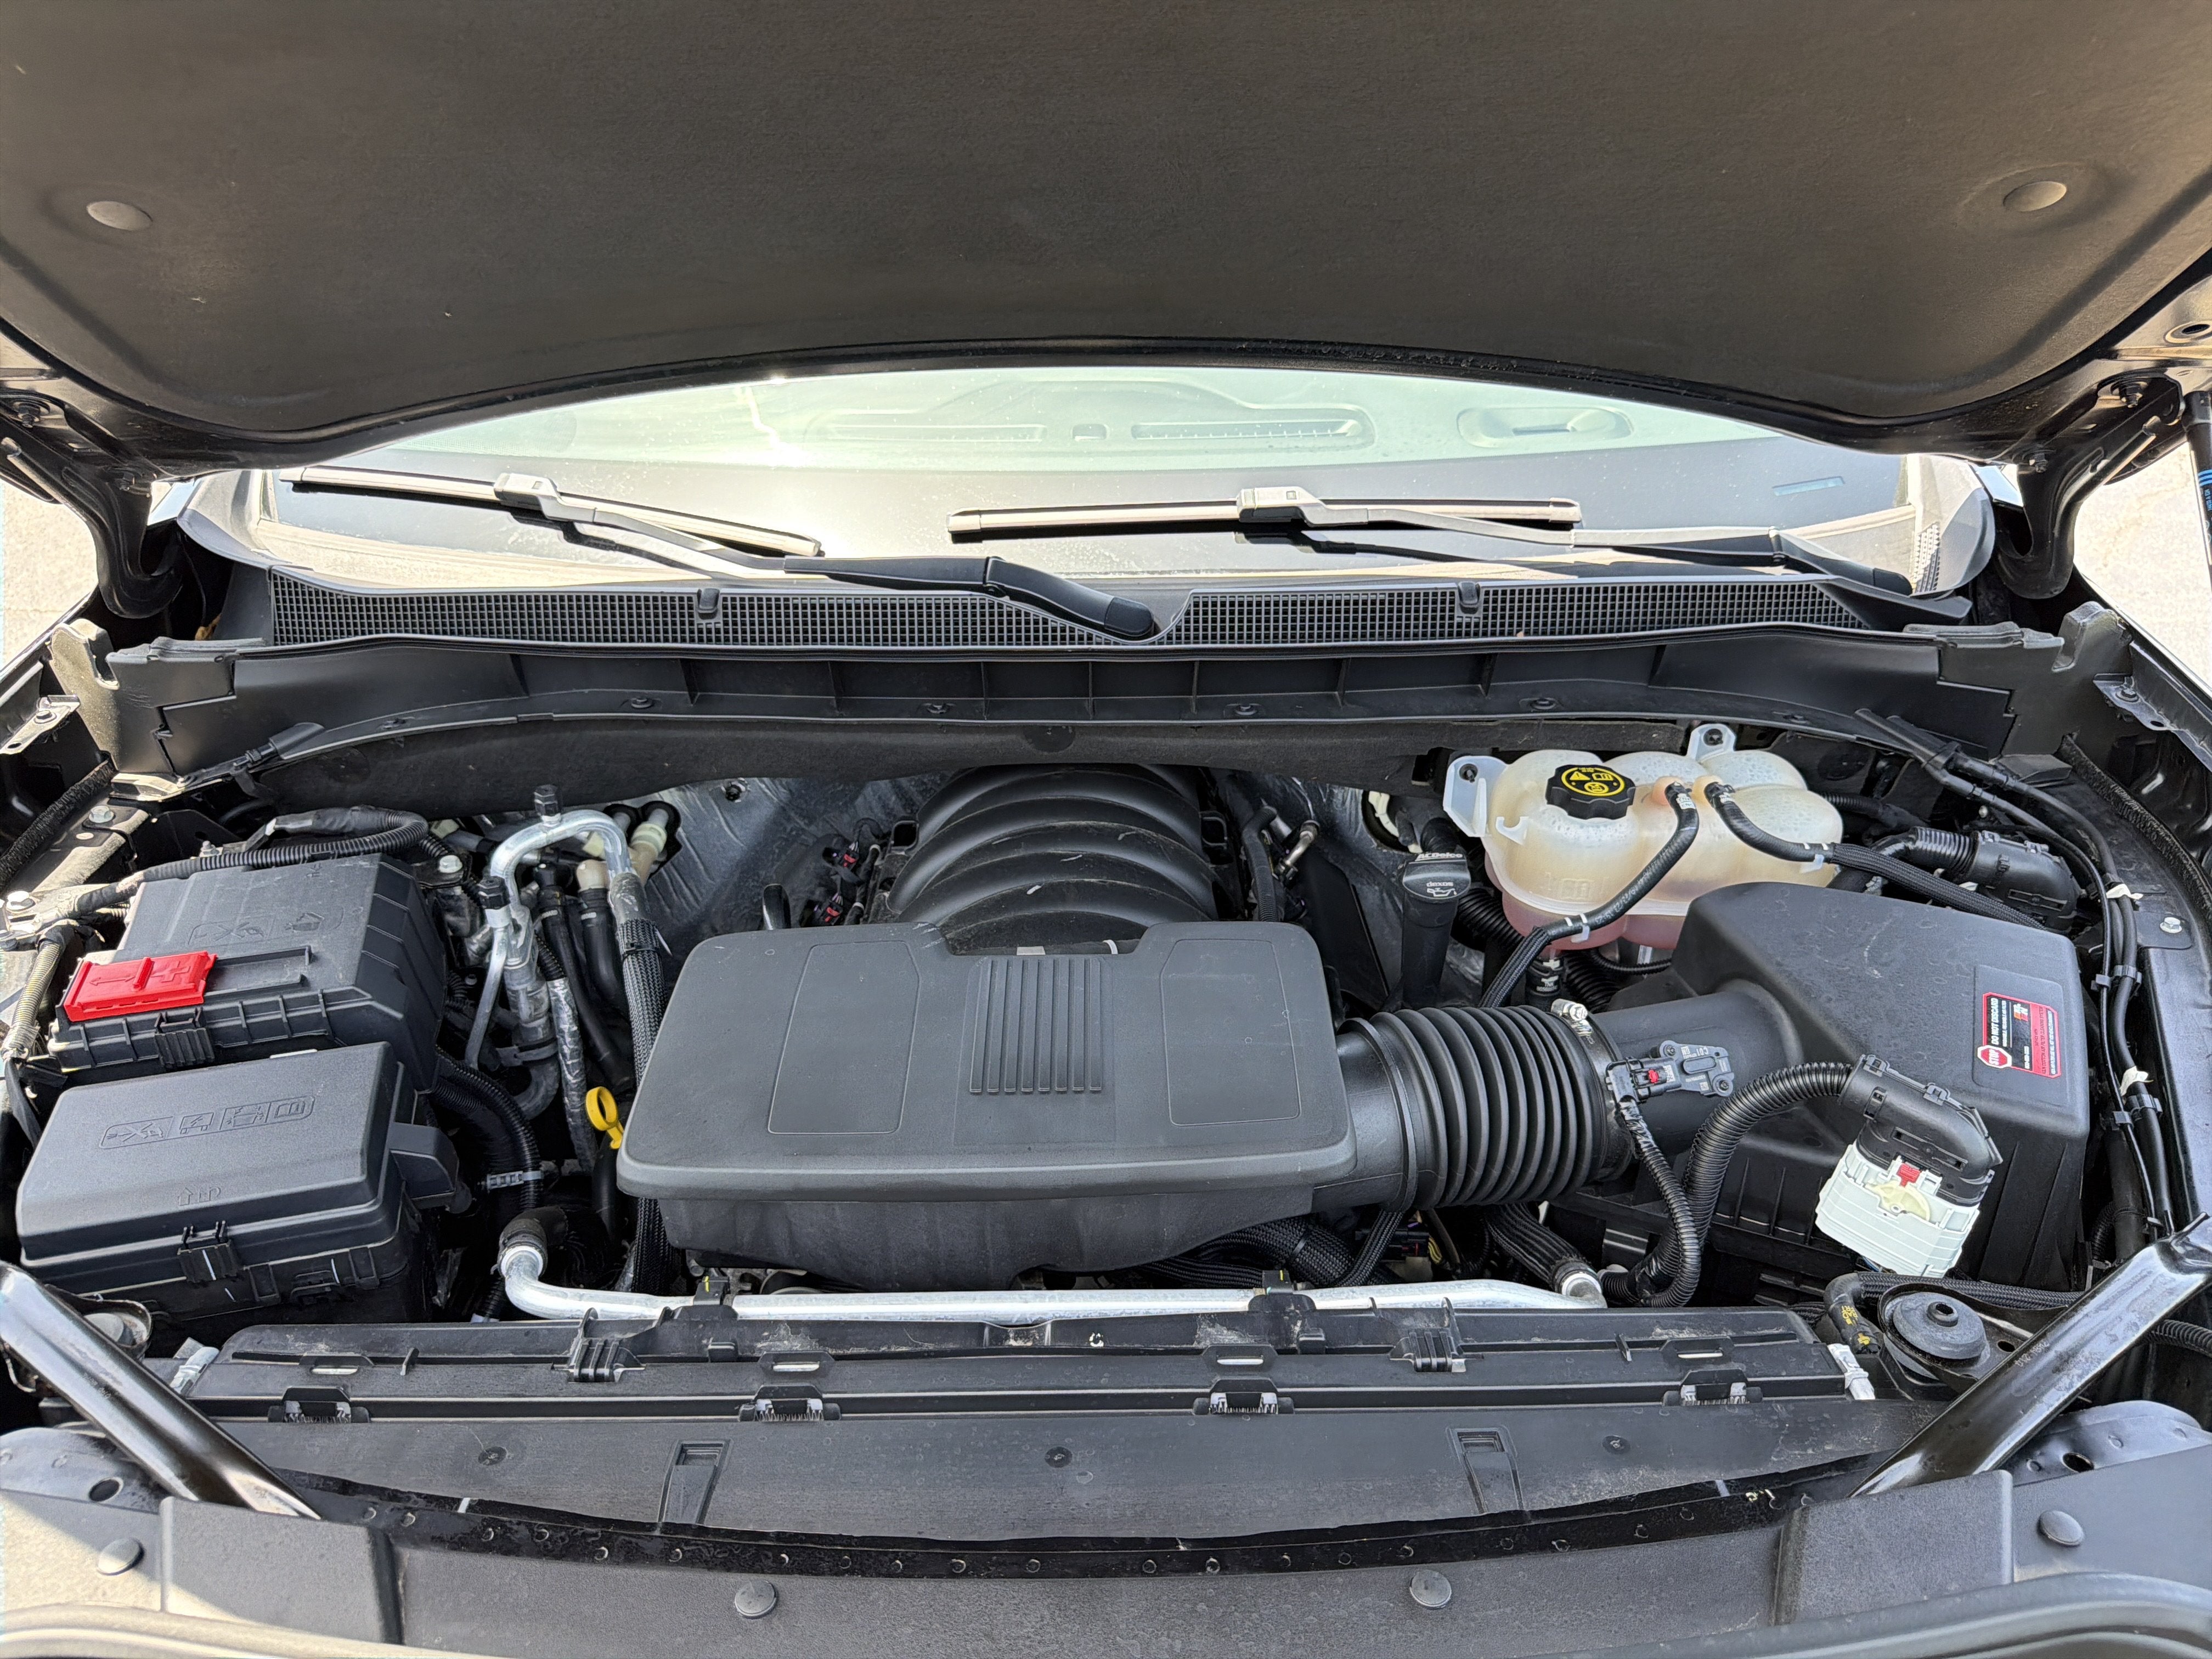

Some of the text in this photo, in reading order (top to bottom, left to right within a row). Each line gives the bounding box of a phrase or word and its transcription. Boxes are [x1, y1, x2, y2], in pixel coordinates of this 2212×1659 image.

[1415, 852, 1463, 861] ACDelco
[1990, 997, 1999, 1045] DO NOT DISCARD
[1989, 1048, 1999, 1065] STOP
